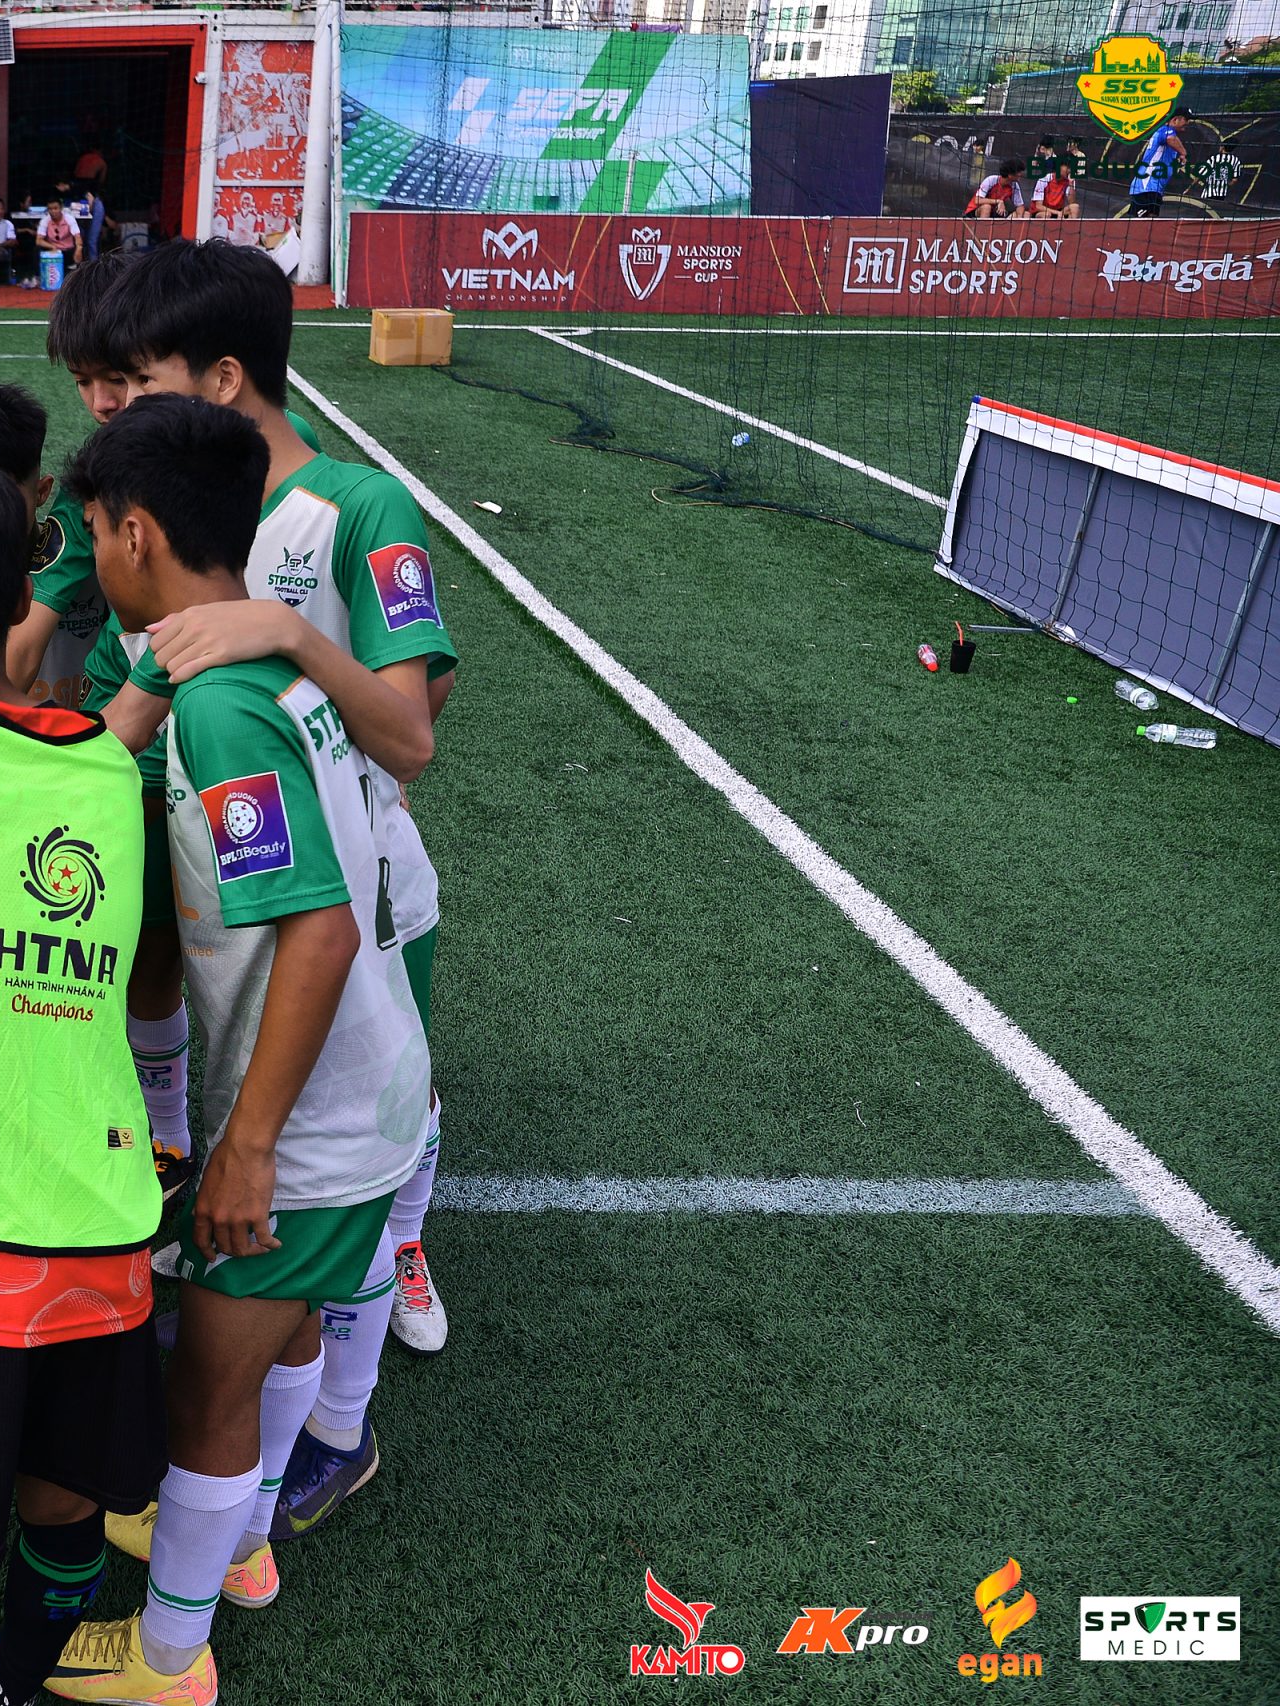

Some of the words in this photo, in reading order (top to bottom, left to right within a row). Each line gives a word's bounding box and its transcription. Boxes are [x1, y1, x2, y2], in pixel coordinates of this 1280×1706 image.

[506, 88, 633, 121] SEFA
[676, 245, 742, 257] MANSION
[912, 238, 1064, 264] MANSION
[683, 259, 733, 271] SPORTS
[441, 267, 576, 291] VIETNAM
[694, 272, 718, 283] CUP
[909, 269, 1019, 295] SPORTS
[445, 294, 568, 302] CHAMPIONSHIP
[4, 976, 35, 990] HÀNH
[36, 980, 65, 993] TRÌNH
[66, 984, 95, 999] NHÂN
[11, 993, 94, 1022] Champions
